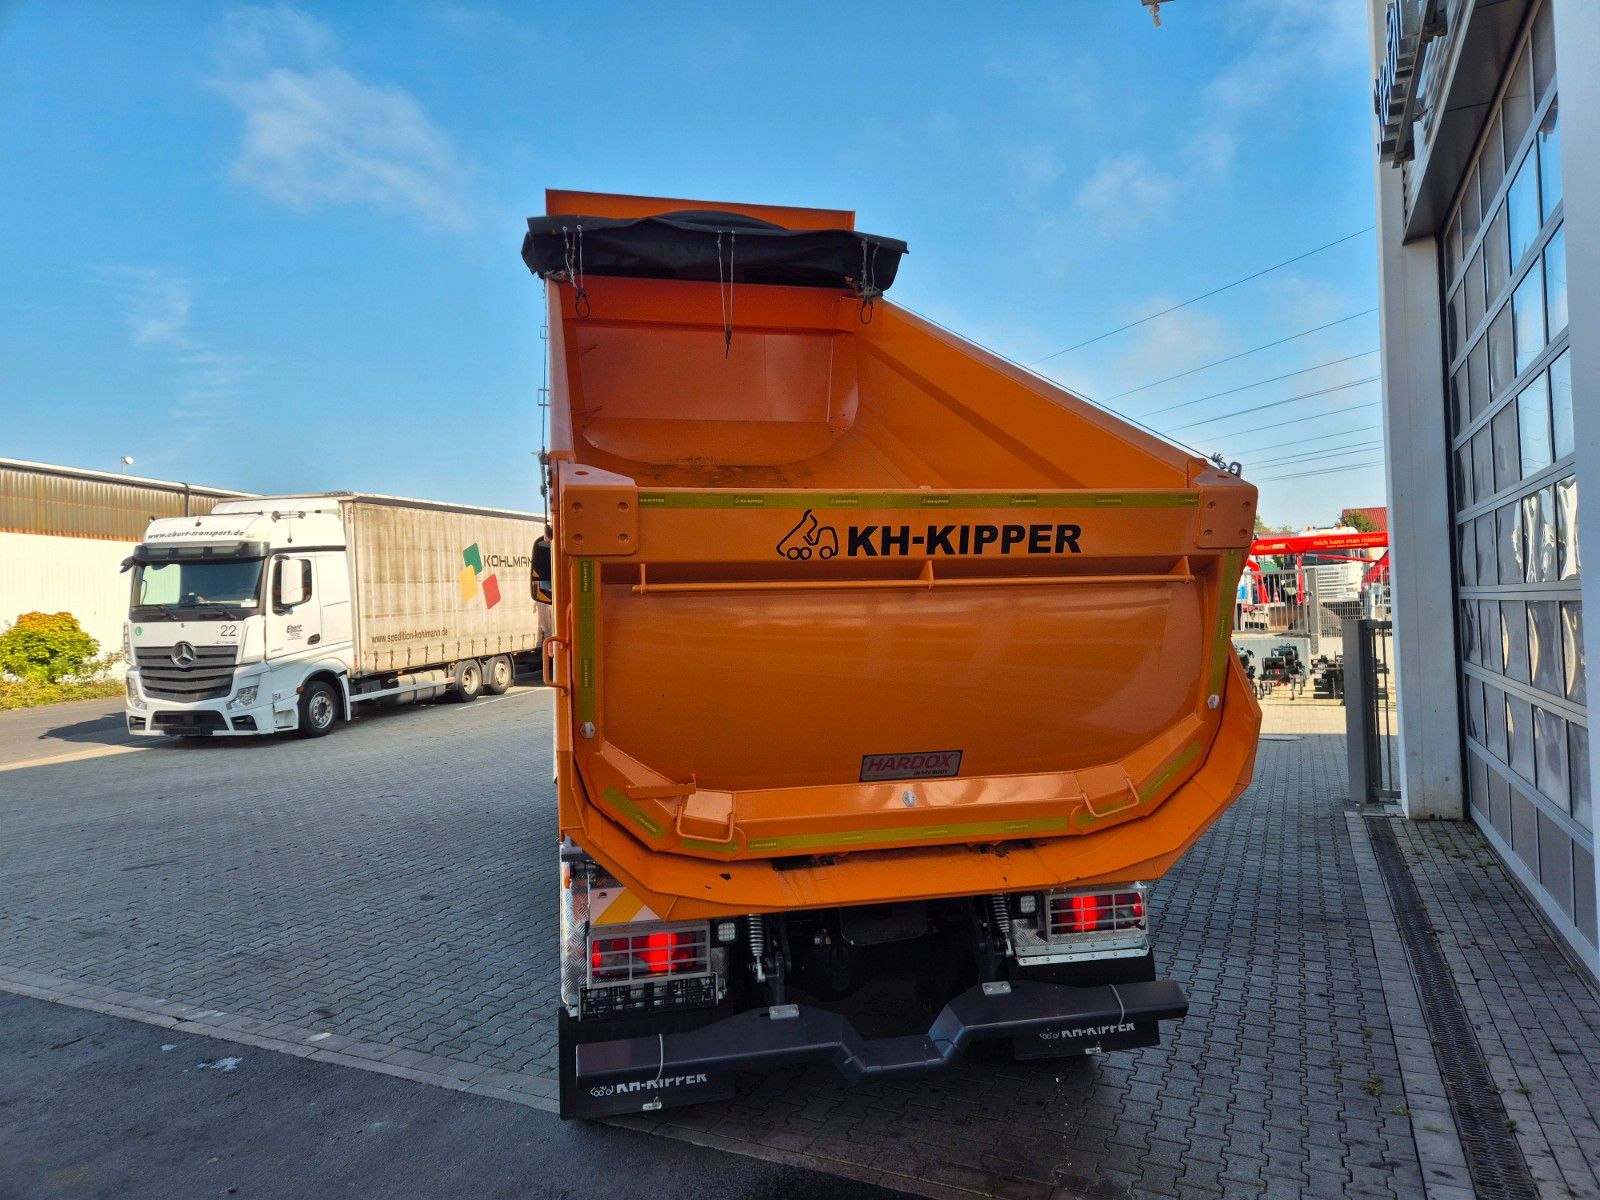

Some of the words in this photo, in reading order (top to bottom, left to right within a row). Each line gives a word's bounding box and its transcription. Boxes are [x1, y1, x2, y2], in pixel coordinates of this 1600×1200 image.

[148, 530, 245, 539] www.ebert-transport.de
[847, 524, 1082, 556] KH-KIPPER
[220, 624, 237, 637] 22
[867, 754, 954, 772] HARDOX
